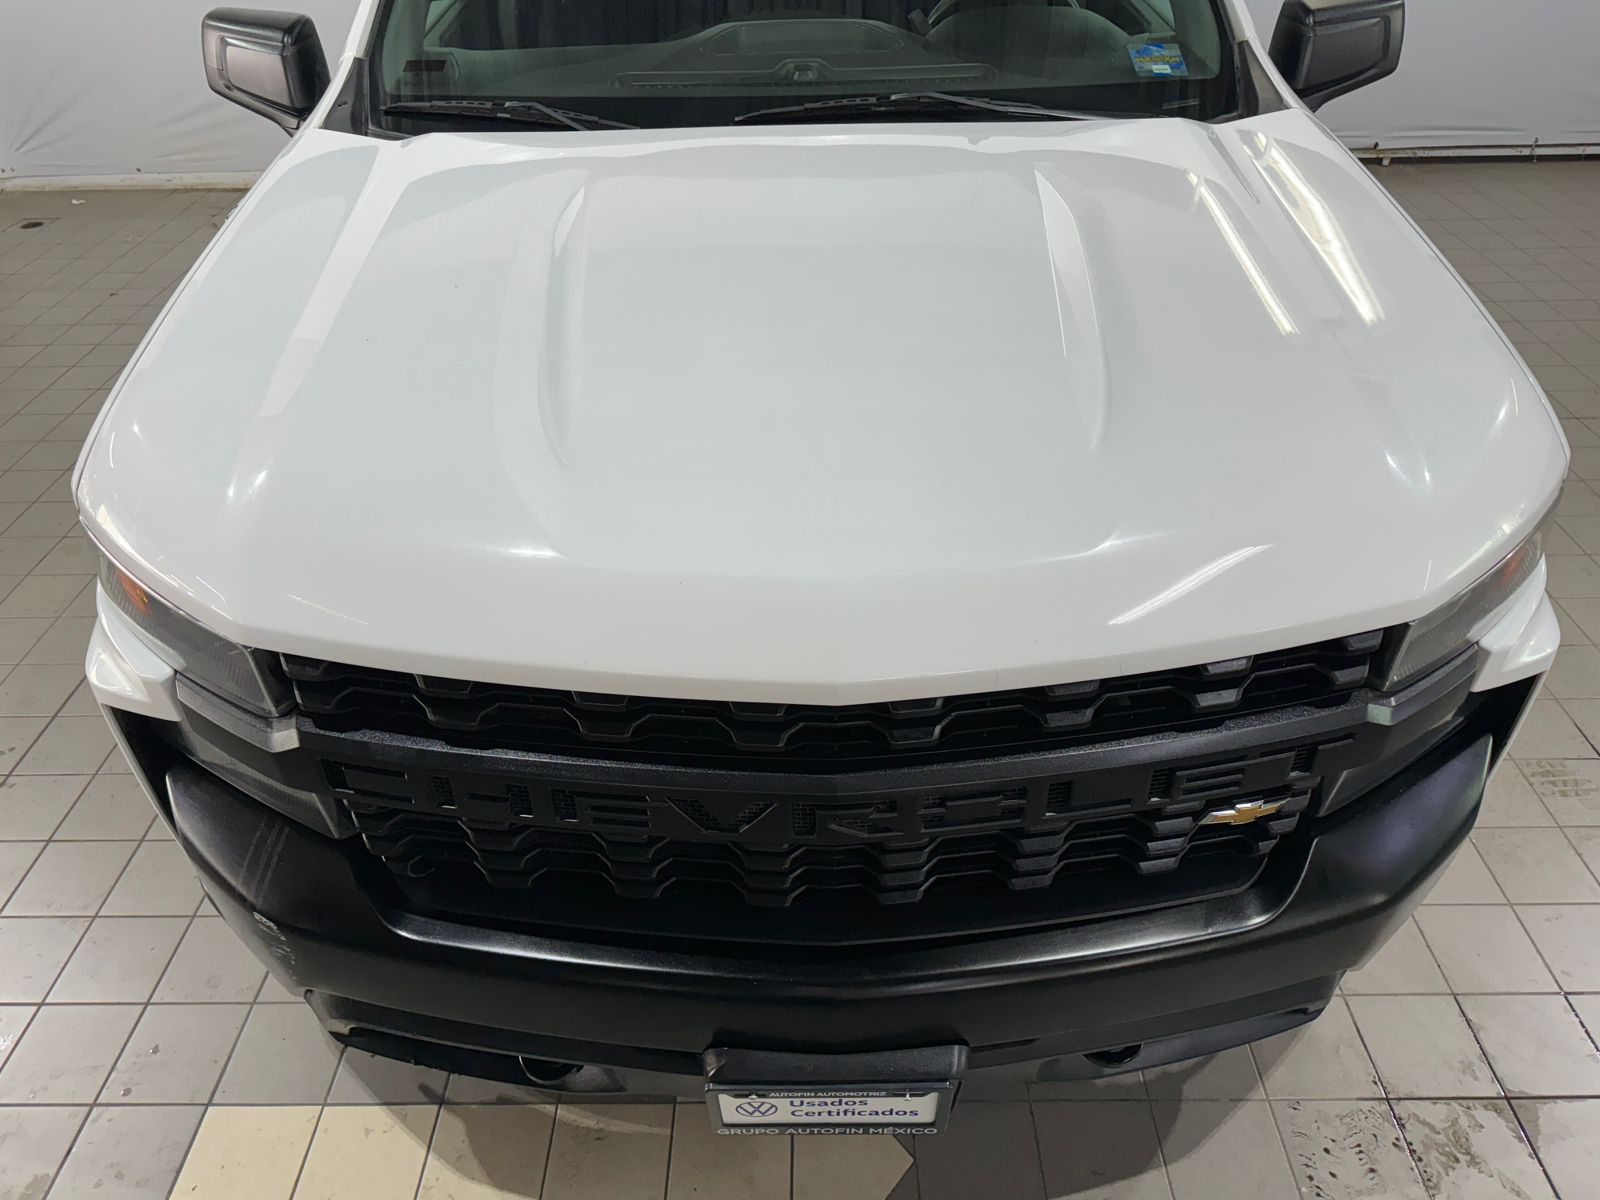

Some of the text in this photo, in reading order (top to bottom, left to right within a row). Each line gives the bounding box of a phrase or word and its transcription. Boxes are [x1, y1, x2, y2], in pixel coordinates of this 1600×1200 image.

[319, 732, 1356, 839] CHEVROLET
[789, 1098, 869, 1108] Usados
[790, 1108, 920, 1117] Certificados
[716, 1127, 780, 1135] GRUPO
[784, 1127, 864, 1135] AUTOFIN
